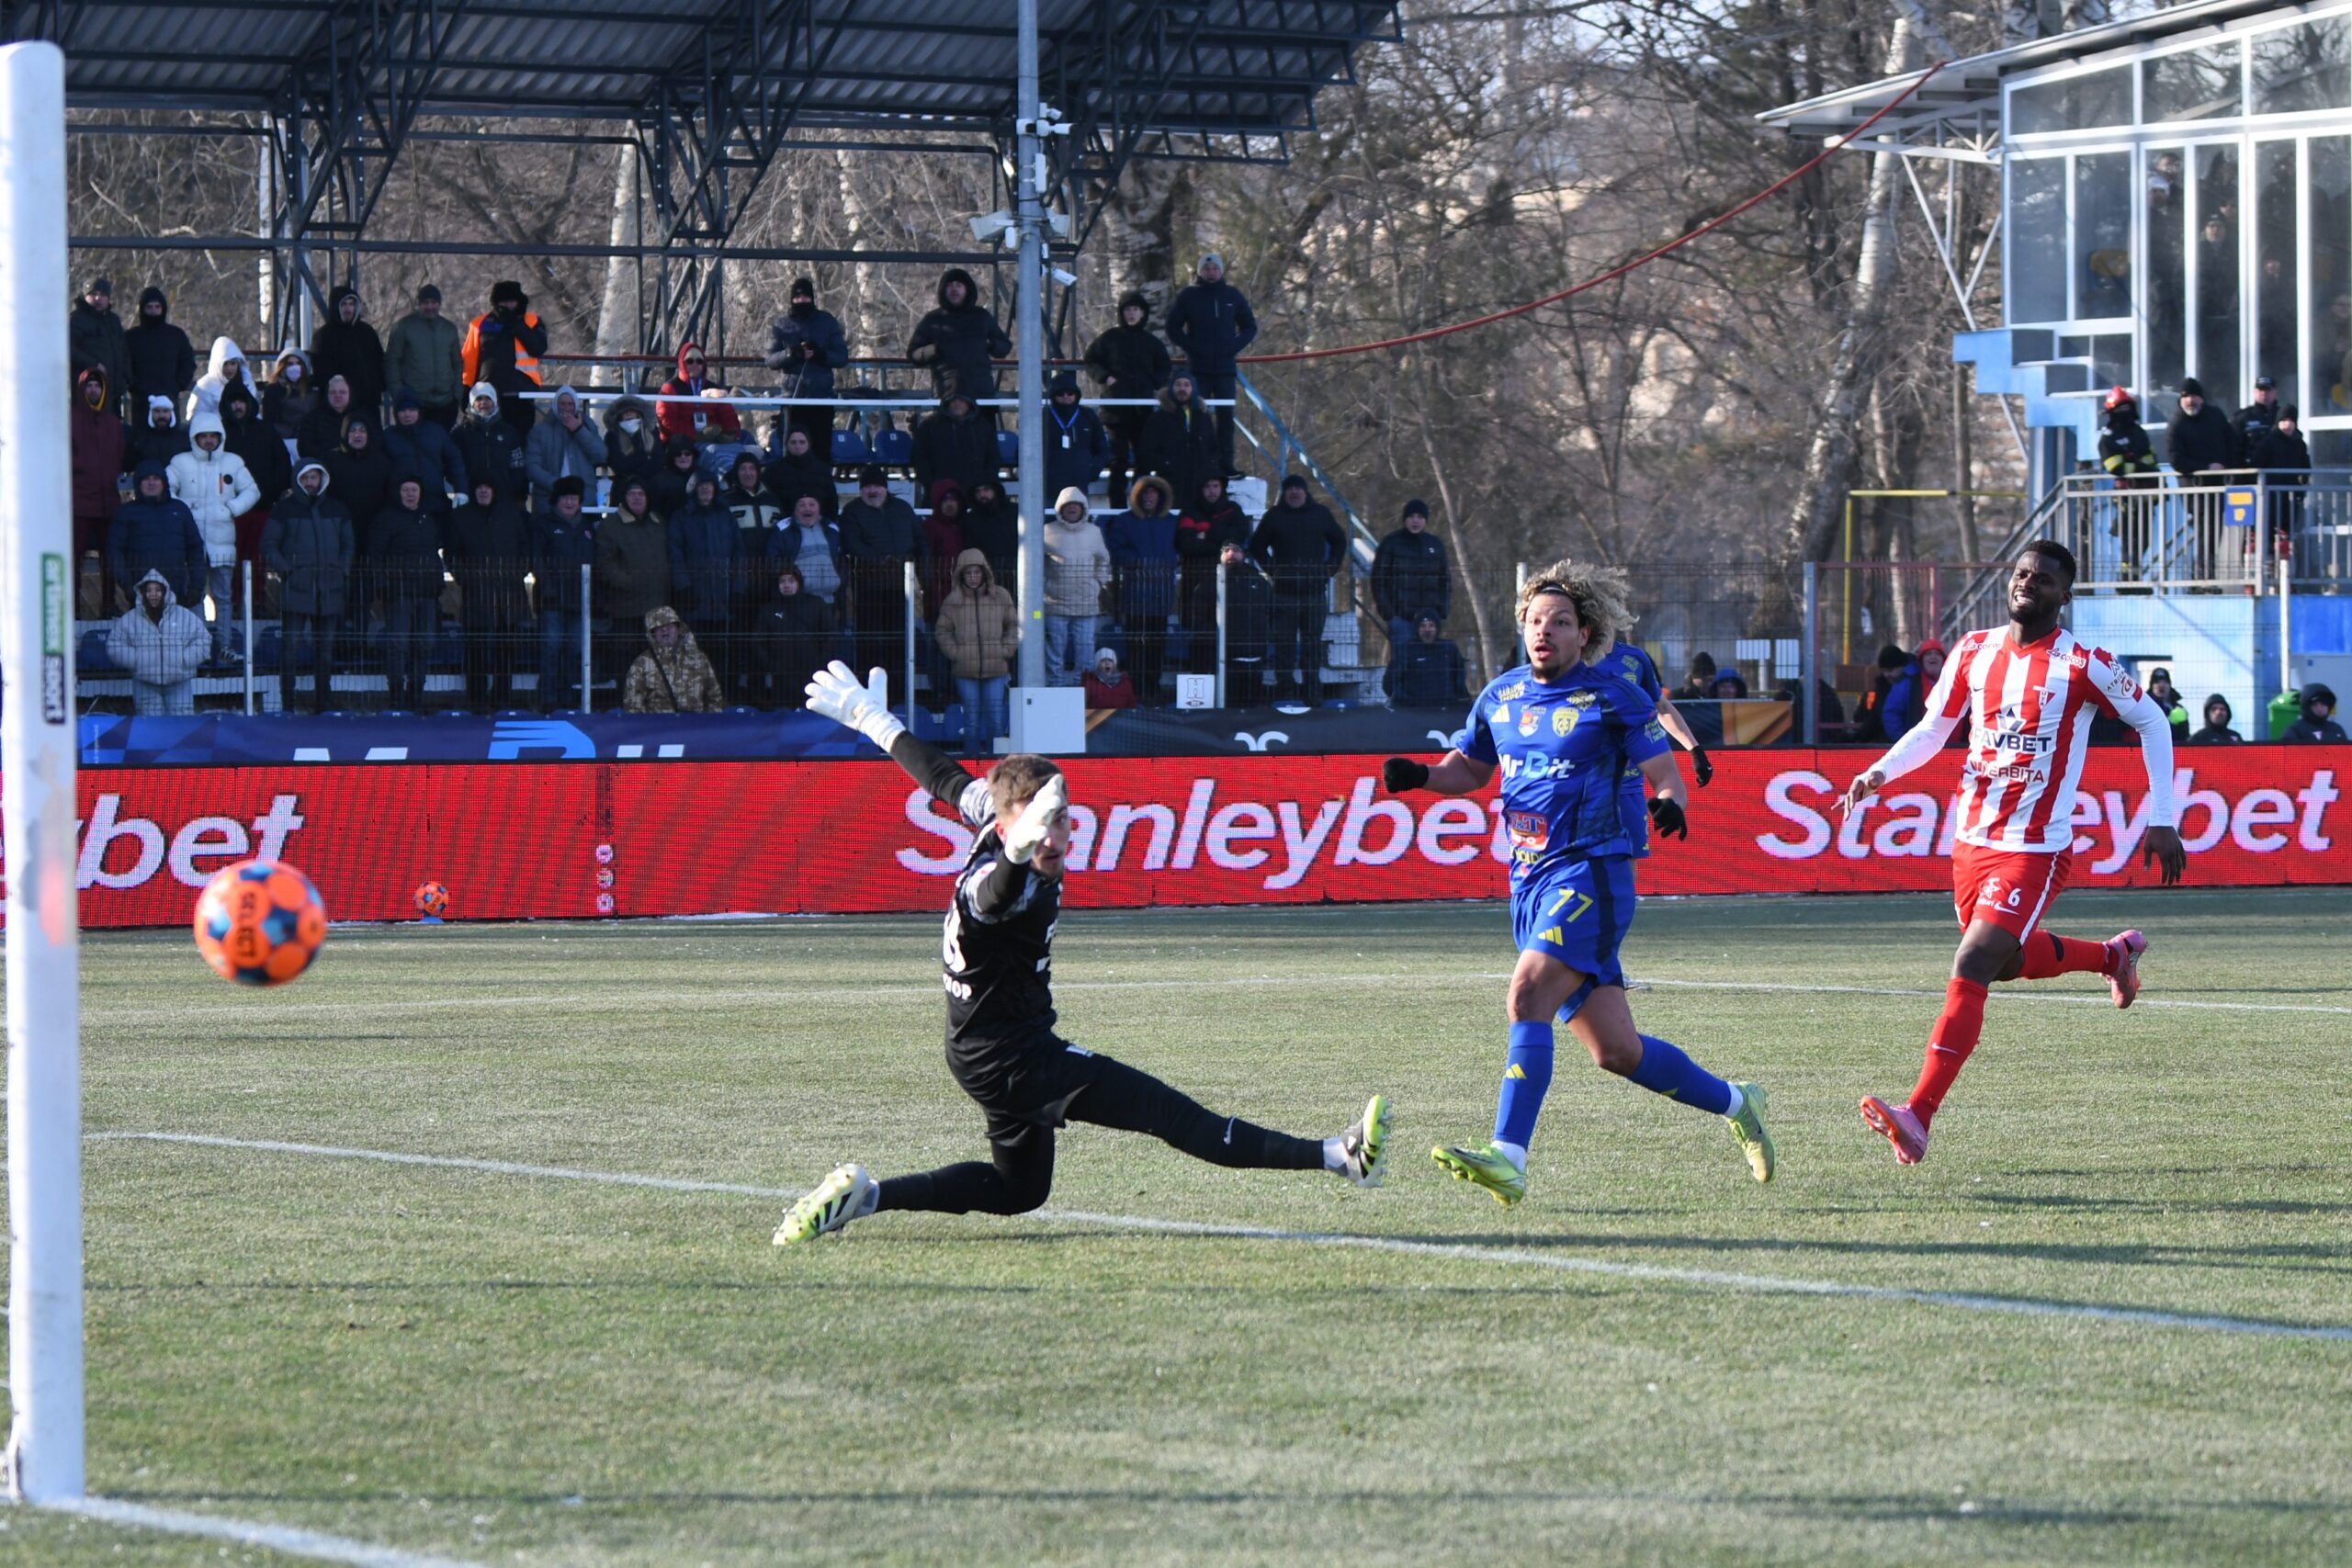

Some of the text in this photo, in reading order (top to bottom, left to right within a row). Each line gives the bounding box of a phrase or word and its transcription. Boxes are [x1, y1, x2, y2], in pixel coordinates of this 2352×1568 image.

[1975, 728, 2052, 752] FAVBET
[1756, 768, 2339, 874] Staeybet
[75, 794, 304, 889] bet
[1547, 888, 1594, 923] 77
[2007, 888, 2021, 907] 6
